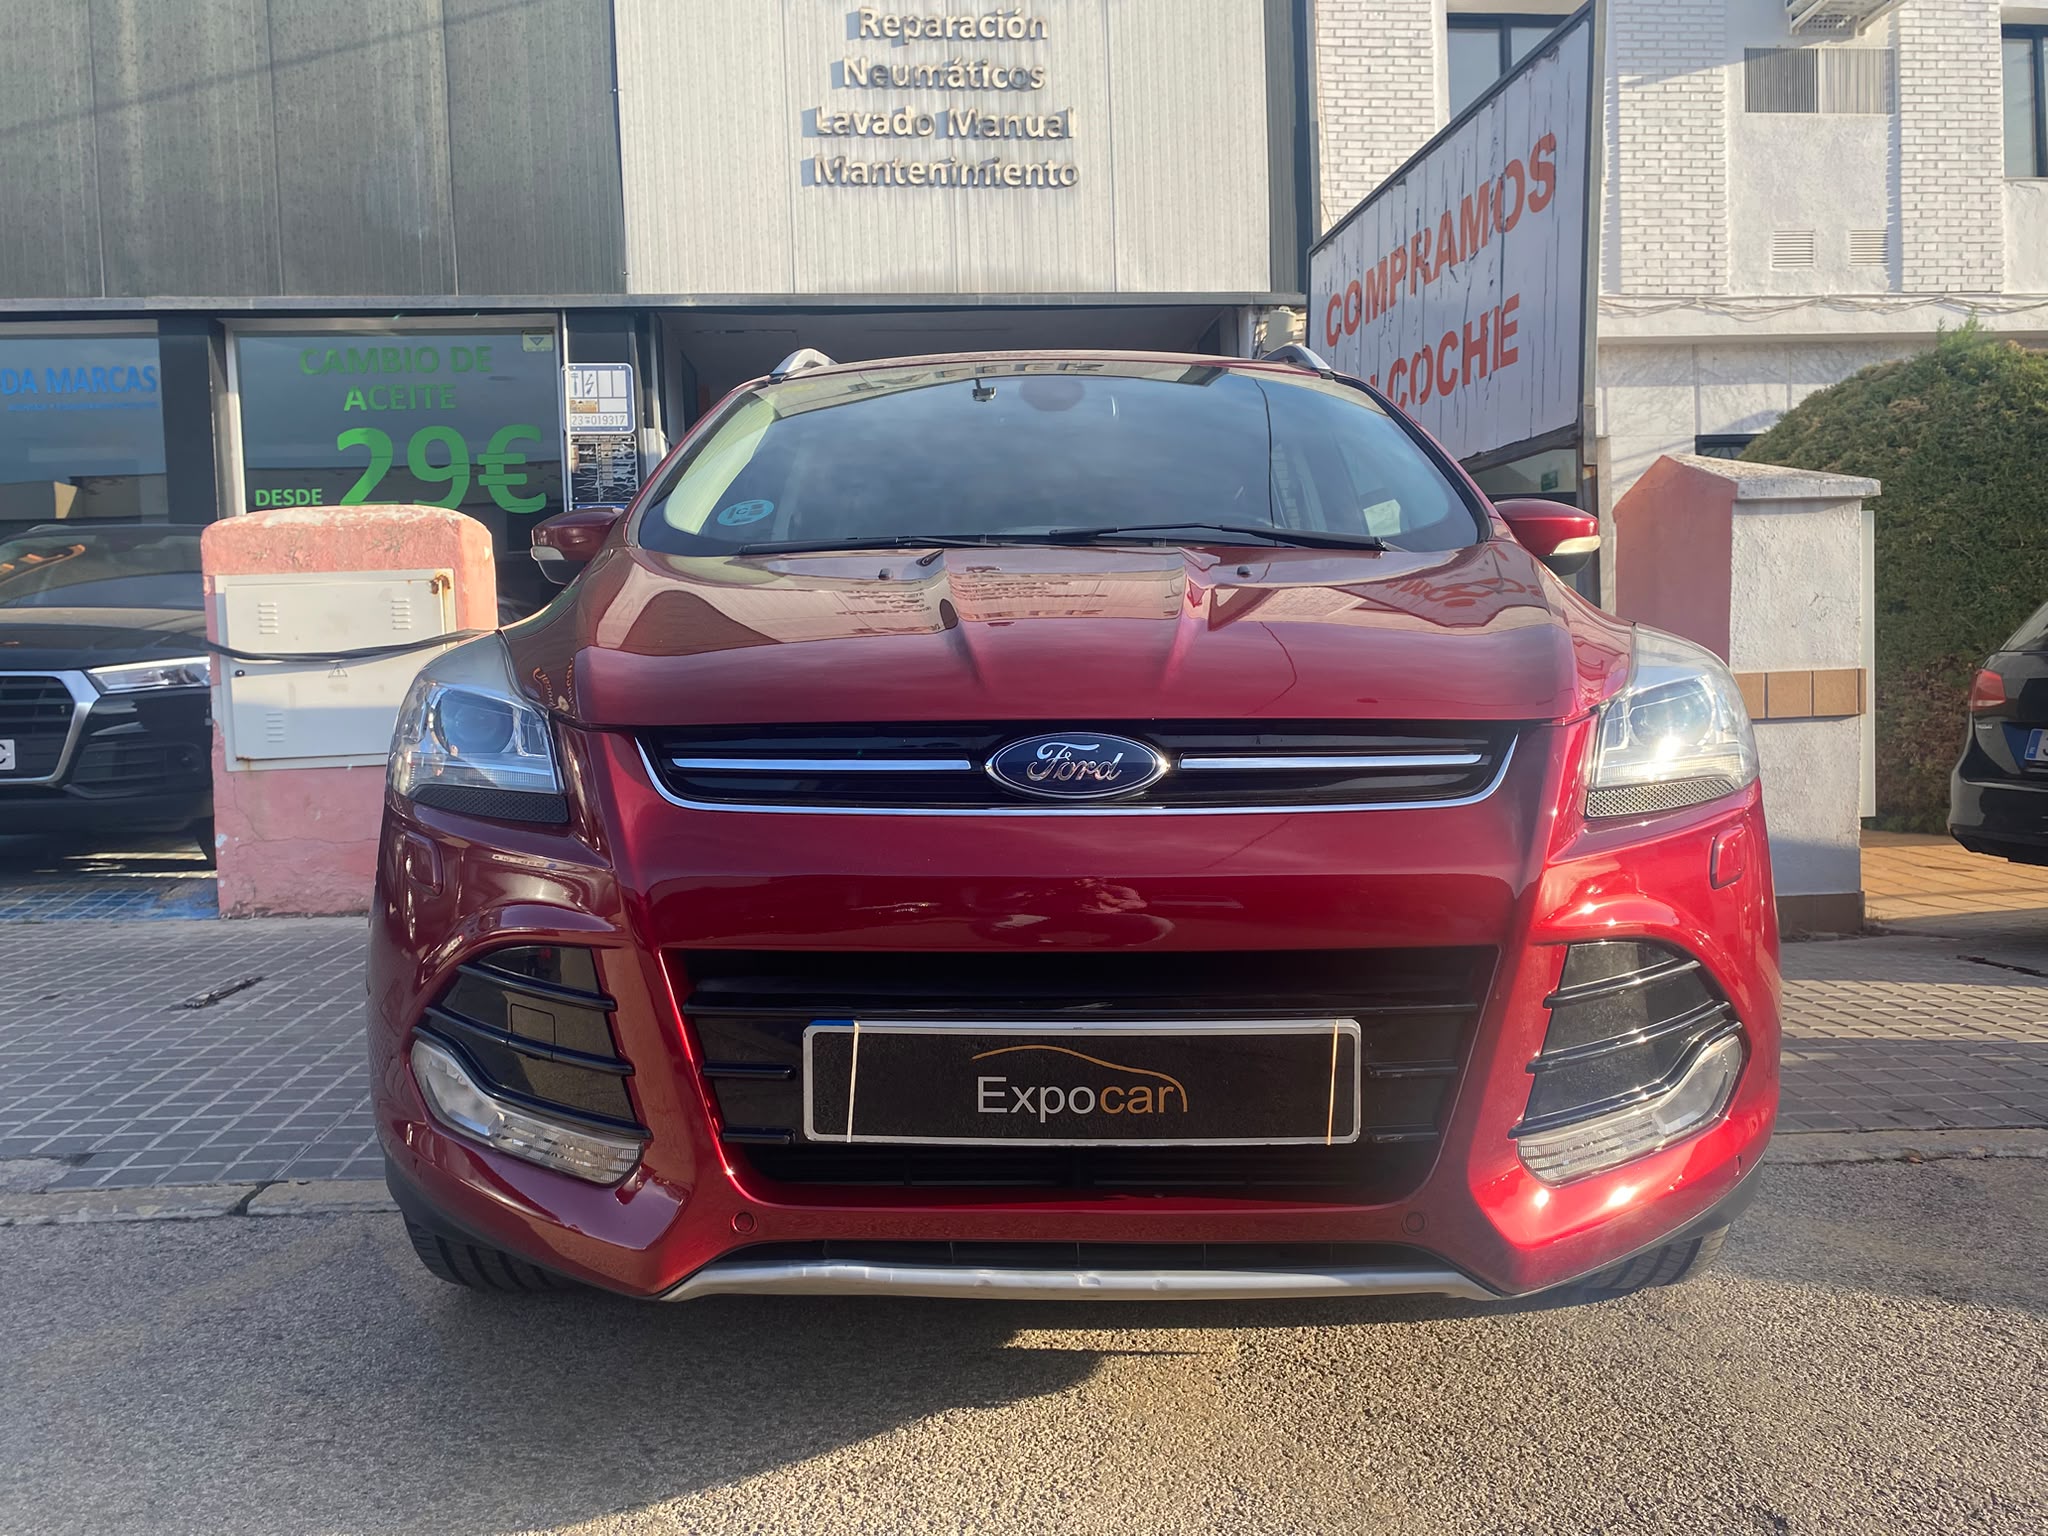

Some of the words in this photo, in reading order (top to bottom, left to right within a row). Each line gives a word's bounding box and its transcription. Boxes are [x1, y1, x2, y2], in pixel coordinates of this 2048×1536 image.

[858, 7, 1049, 45] Reparación
[841, 56, 1046, 90] Neumáticos
[814, 105, 936, 137] Lavado
[947, 106, 1078, 139] Manual
[812, 154, 1080, 188] Mantenimiento
[1325, 131, 1558, 348] COMPRAMOS
[301, 346, 440, 376] CAMBIO
[451, 345, 494, 373] DE
[1387, 290, 1520, 410] COCHE
[0, 367, 39, 396] DA
[45, 364, 158, 394] MARCAS
[343, 384, 457, 412] ACEITE
[255, 488, 323, 507] DESDE
[337, 424, 547, 514] 29€
[1026, 742, 1124, 781] Ford
[976, 1075, 1175, 1124] Expocar
